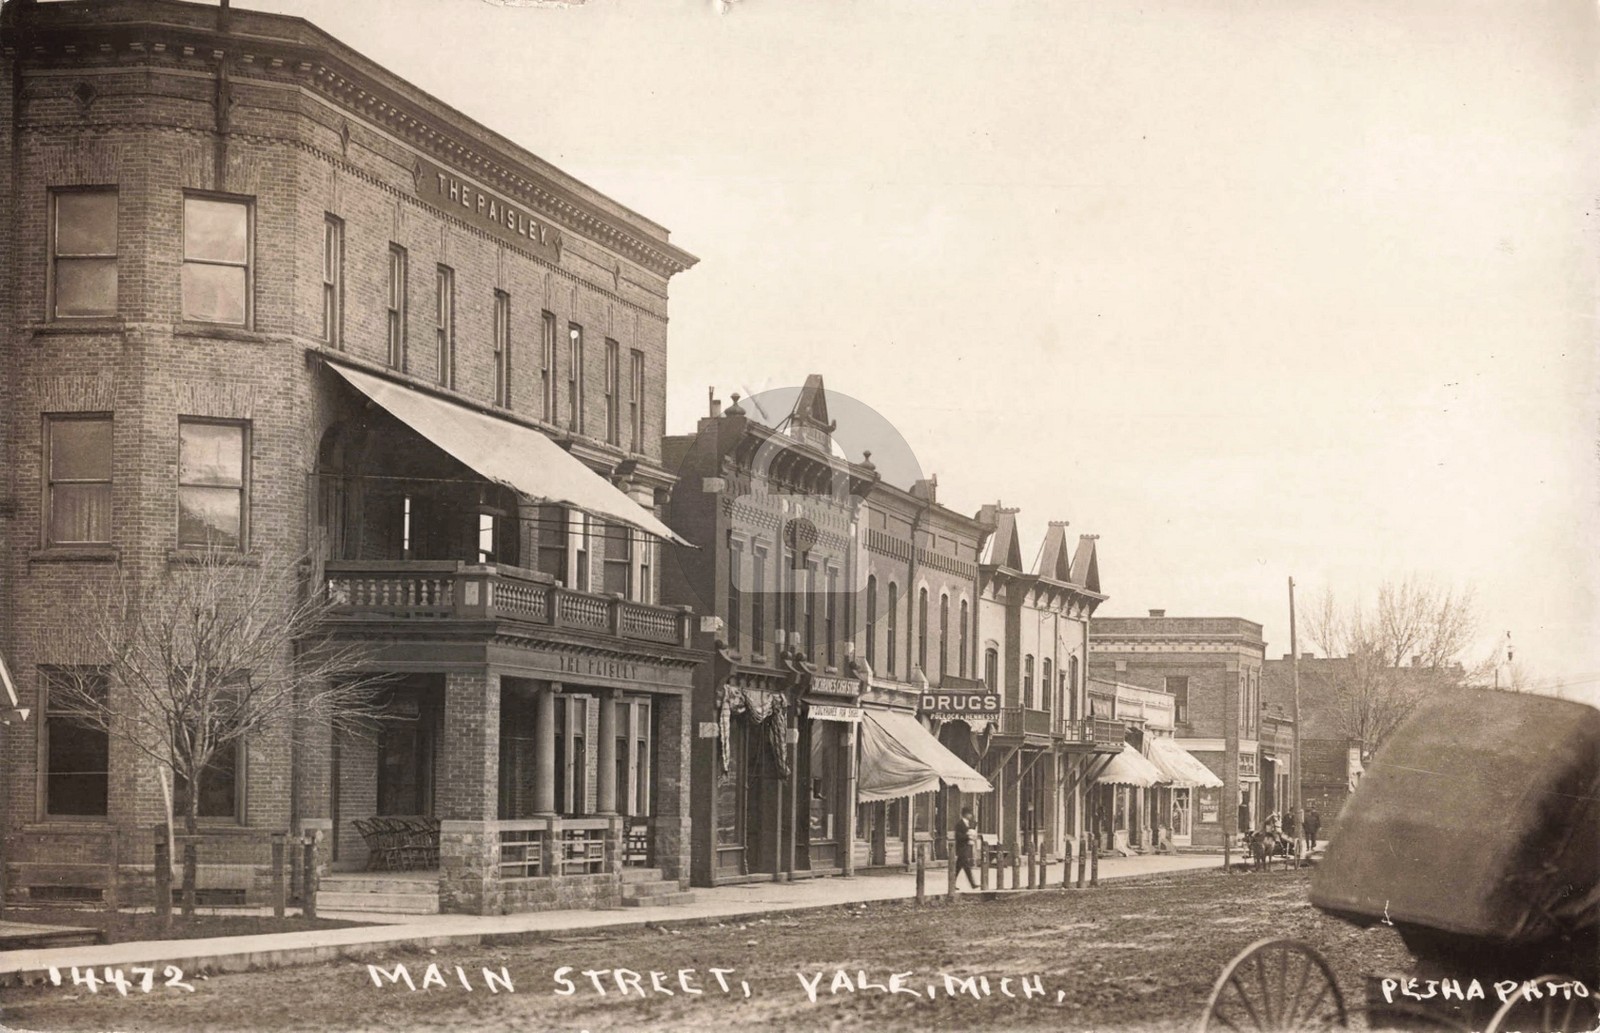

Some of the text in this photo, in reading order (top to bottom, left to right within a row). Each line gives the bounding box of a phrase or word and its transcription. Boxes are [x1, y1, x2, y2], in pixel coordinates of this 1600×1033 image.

[436, 172, 471, 208] THE
[559, 655, 580, 674] THE
[922, 695, 997, 710] DRUGS
